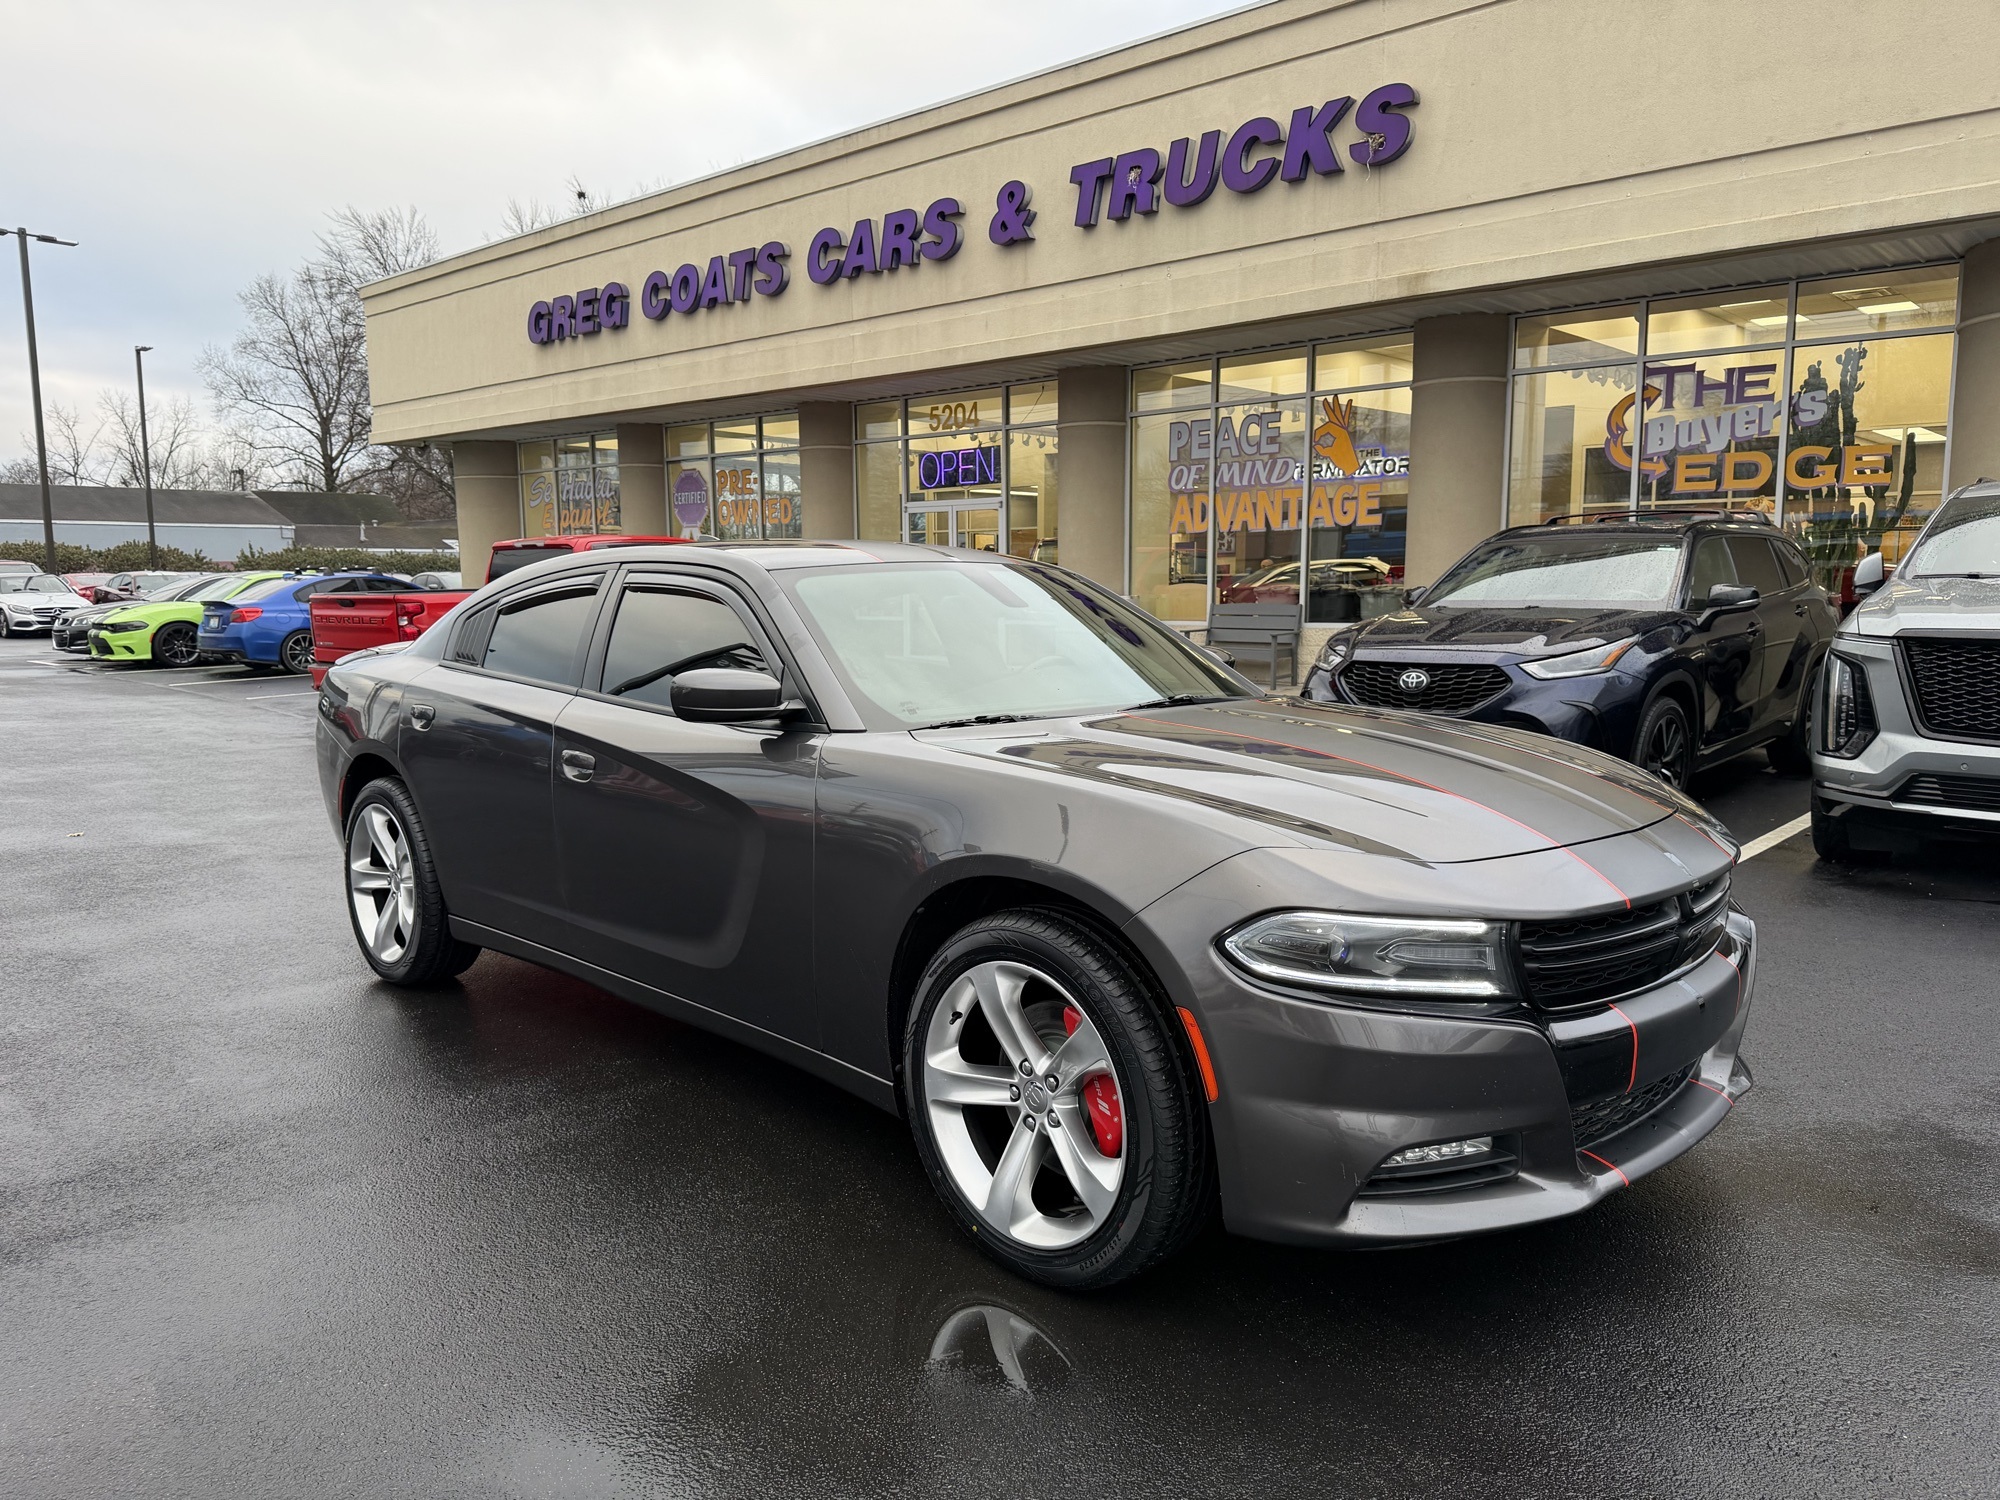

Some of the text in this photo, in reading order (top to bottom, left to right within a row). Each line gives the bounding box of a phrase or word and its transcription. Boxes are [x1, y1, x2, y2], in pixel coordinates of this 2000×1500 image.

[527, 82, 1420, 344] GREG COATS CARS & TRUCKS
[1645, 362, 1777, 410] THE
[928, 401, 980, 432] 5204
[1169, 411, 1282, 462] PEACE
[1359, 448, 1381, 458] THE
[716, 468, 758, 497] PRE-
[919, 447, 995, 488] OPEN
[1168, 457, 1298, 492] OF MIND
[1671, 445, 1893, 494] EDGE
[529, 469, 615, 508] Se Habla
[673, 490, 707, 505] CERTIFIED
[542, 499, 615, 535] Epañl
[718, 498, 793, 526] OWNED
[1169, 482, 1383, 534] ADVANTAGE
[314, 616, 387, 625] CHEVROLET
